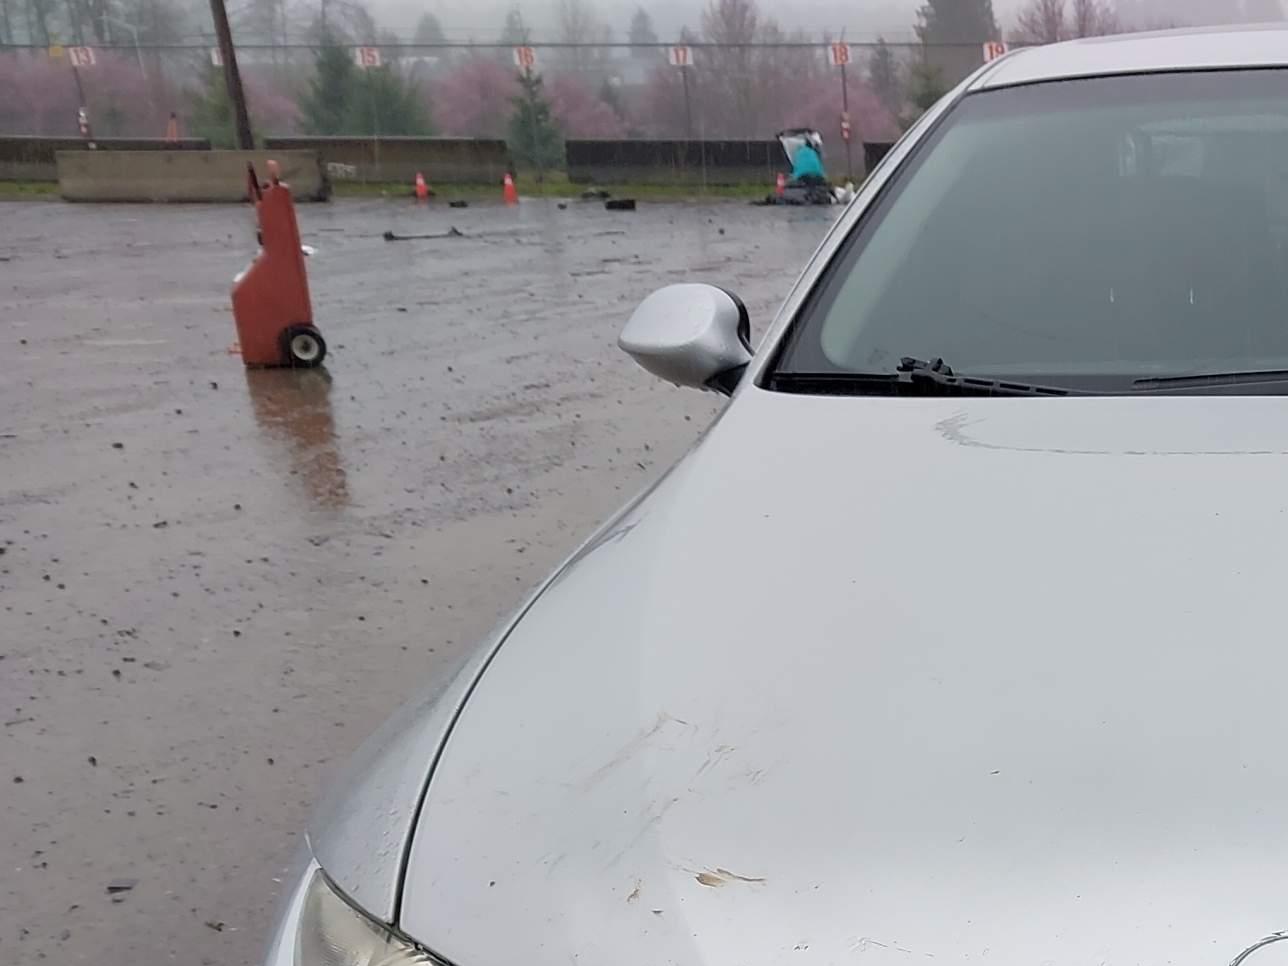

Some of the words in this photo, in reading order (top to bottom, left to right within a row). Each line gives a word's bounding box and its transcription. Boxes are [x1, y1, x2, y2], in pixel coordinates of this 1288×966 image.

[75, 48, 92, 65] 13
[359, 47, 377, 64] 15
[516, 47, 536, 64] 16
[674, 47, 688, 63] 17
[832, 43, 849, 64] 18
[987, 43, 1004, 60] 19
